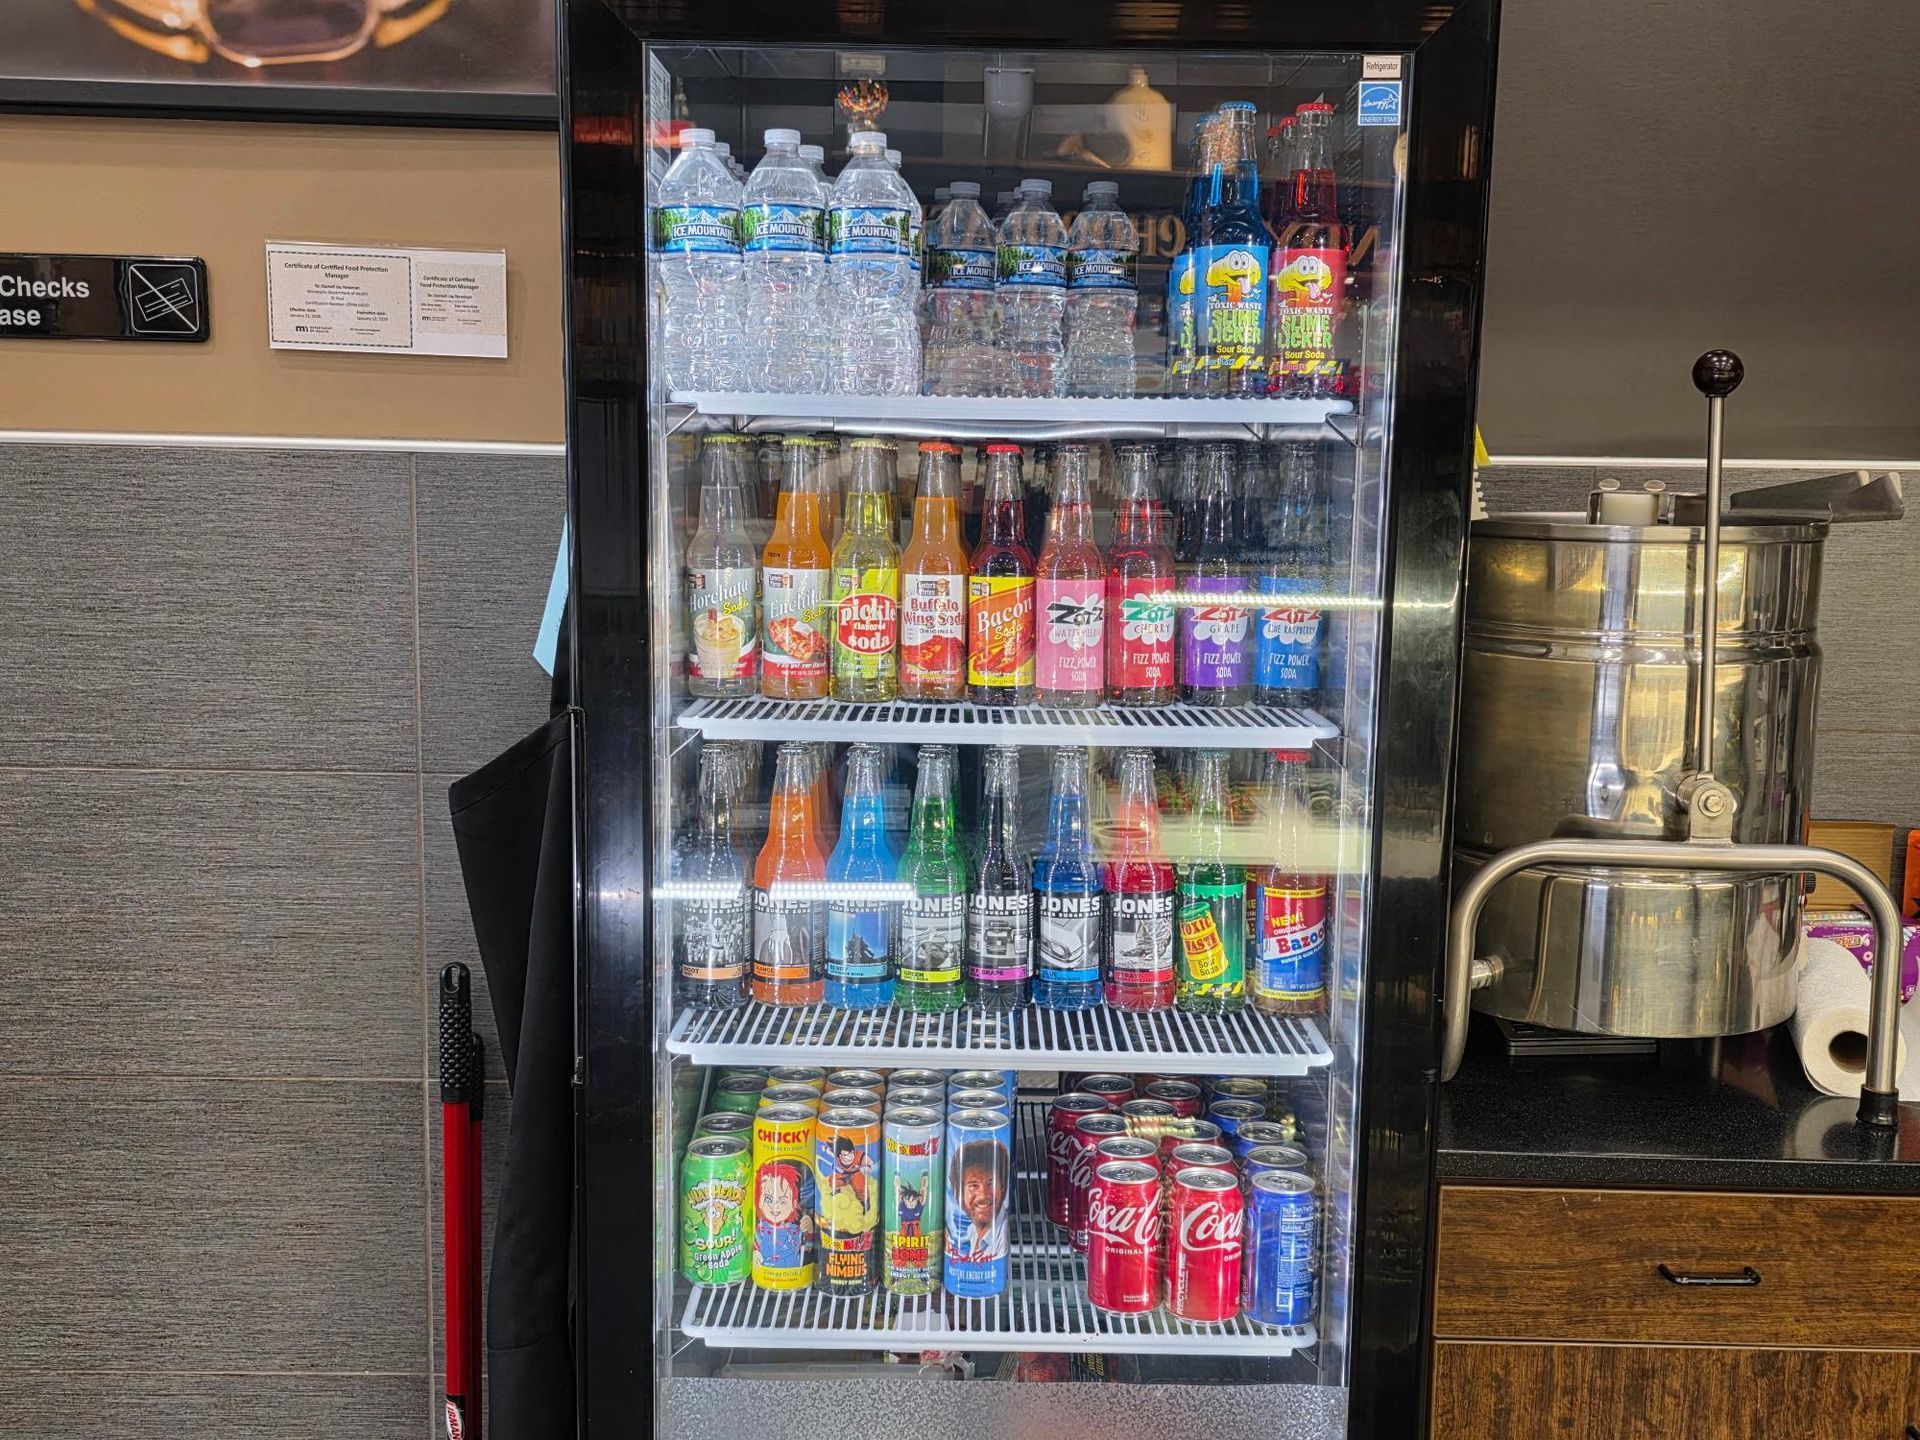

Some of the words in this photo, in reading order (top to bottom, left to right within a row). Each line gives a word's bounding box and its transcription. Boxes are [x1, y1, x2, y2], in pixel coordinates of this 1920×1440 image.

[1366, 62, 1398, 72] Refrigerator
[673, 226, 687, 238] ICE
[687, 225, 734, 240] MOUNTAIN
[756, 223, 769, 236] ICE
[769, 223, 815, 240] MOUNTAIN
[838, 226, 851, 238] ICE
[851, 224, 900, 240] MOUNTAIN
[284, 262, 313, 270] Certificate
[952, 265, 965, 276] ICE
[1018, 261, 1031, 273] ICE
[1074, 265, 1085, 277] ICE
[1086, 264, 1125, 279] MOUNTAIN
[325, 272, 349, 280] Manager
[0, 275, 90, 298] Checks
[1209, 302, 1237, 310] TOXIC
[1237, 302, 1262, 310] WASTE
[1278, 306, 1305, 315] TOXIC
[1306, 306, 1333, 315] WASTE
[0, 309, 41, 326] ase
[1212, 310, 1260, 329] SLIME
[1281, 315, 1330, 334] SLIME
[1208, 326, 1262, 344] LICKER
[1278, 331, 1333, 350] LICKER
[1216, 345, 1236, 354] Sour
[1237, 345, 1255, 354] Soda
[1284, 350, 1304, 359] Sour
[1305, 350, 1325, 359] Soda
[688, 579, 749, 613] Horchata
[722, 598, 749, 616] Soda
[840, 597, 896, 626] pickle
[910, 598, 959, 612] Buffalo
[802, 606, 827, 623] Soda
[903, 611, 935, 629] Wing
[937, 611, 966, 626] Soda
[977, 596, 1032, 633] Bacon
[995, 620, 1023, 641] Soda
[1134, 624, 1170, 634] CHERRY
[1209, 624, 1241, 634] GRAPE
[1283, 626, 1316, 635] RASPBERRY
[848, 633, 890, 650] soda
[1059, 657, 1077, 669] FIZZ
[1077, 657, 1097, 669] POWER
[1133, 653, 1149, 665] FIZZ
[1151, 653, 1170, 665] POWER
[1203, 653, 1220, 665] FIZZ
[1222, 653, 1242, 665] POWER
[1269, 653, 1285, 665] FIZZ
[1287, 654, 1309, 666] POWER
[1071, 671, 1087, 682] SODA
[1145, 667, 1161, 678] SODA
[1216, 667, 1233, 678] SODA
[1280, 667, 1297, 679] SODA
[901, 896, 962, 912] JONES
[969, 893, 1028, 911] JONES
[1040, 896, 1101, 913] JONES
[1113, 896, 1173, 914] JONES
[1181, 916, 1213, 936] TOXIC
[1271, 912, 1304, 928] NEW!
[1273, 924, 1308, 936] ORIGINAL
[1184, 932, 1219, 952] WASTE
[1197, 959, 1216, 969] Sour
[1280, 955, 1303, 965] BUBBLE
[1302, 952, 1314, 960] GUM
[683, 966, 700, 974] ROOT
[903, 970, 925, 978] GREEN
[1200, 965, 1220, 977] Soda
[757, 1128, 811, 1144] CHUCKY
[695, 1229, 737, 1251] SOUR!
[892, 1234, 930, 1248] SPIRIT
[694, 1249, 719, 1262] Green
[720, 1243, 743, 1258] Apple
[891, 1247, 929, 1263] BOMB
[949, 1248, 972, 1265] Bob
[1105, 1246, 1143, 1255] ORIGINAL
[708, 1257, 730, 1270] Soda
[828, 1252, 865, 1265] FLYING
[826, 1264, 868, 1278] NIMBUS
[965, 1271, 984, 1281] ENERGY
[1176, 1271, 1186, 1315] RECYCLE
